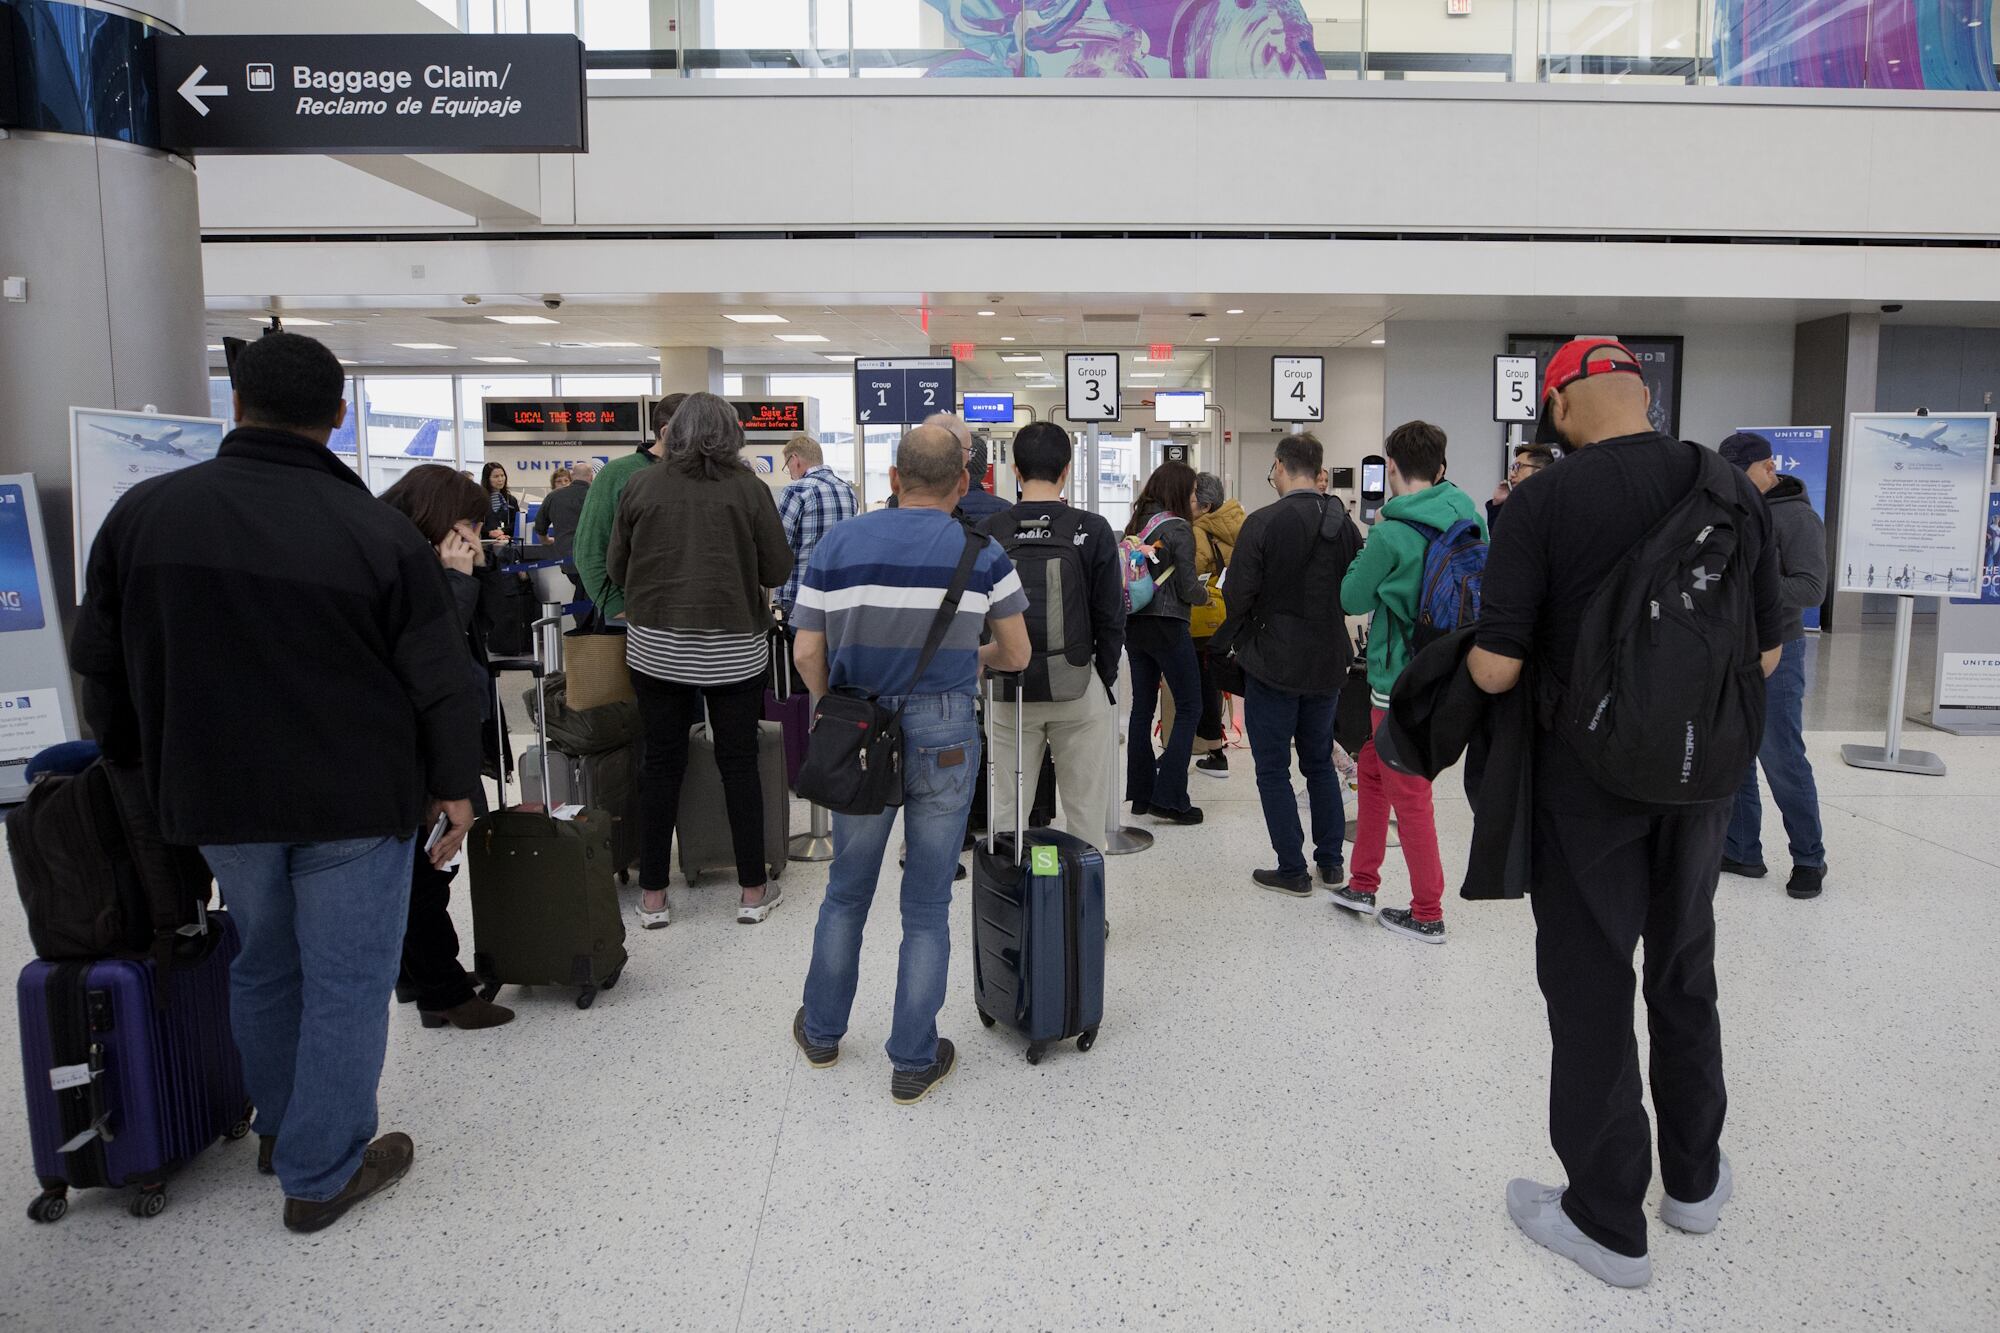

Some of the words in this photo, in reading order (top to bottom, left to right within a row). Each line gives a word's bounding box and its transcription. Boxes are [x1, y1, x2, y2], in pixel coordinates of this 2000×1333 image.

[293, 65, 412, 94] Baggage
[423, 63, 512, 90] Claim/
[296, 96, 387, 115] Reclamo
[396, 96, 422, 115] de
[430, 96, 522, 118] Equipaje
[1151, 345, 1172, 360] EXIT
[1078, 367, 1107, 377] Group
[1284, 370, 1312, 380] Group
[1505, 369, 1529, 379] Group
[872, 381, 891, 389] Group
[919, 381, 939, 389] Group
[1085, 379, 1100, 401] 3
[1290, 381, 1306, 402] 4
[1511, 381, 1523, 402] 5
[877, 389, 887, 407] 1
[923, 388, 935, 406] 2
[514, 410, 544, 424] LOCAL
[600, 410, 615, 424] AM
[517, 460, 587, 471] UNITE
[1038, 852, 1052, 868] S
